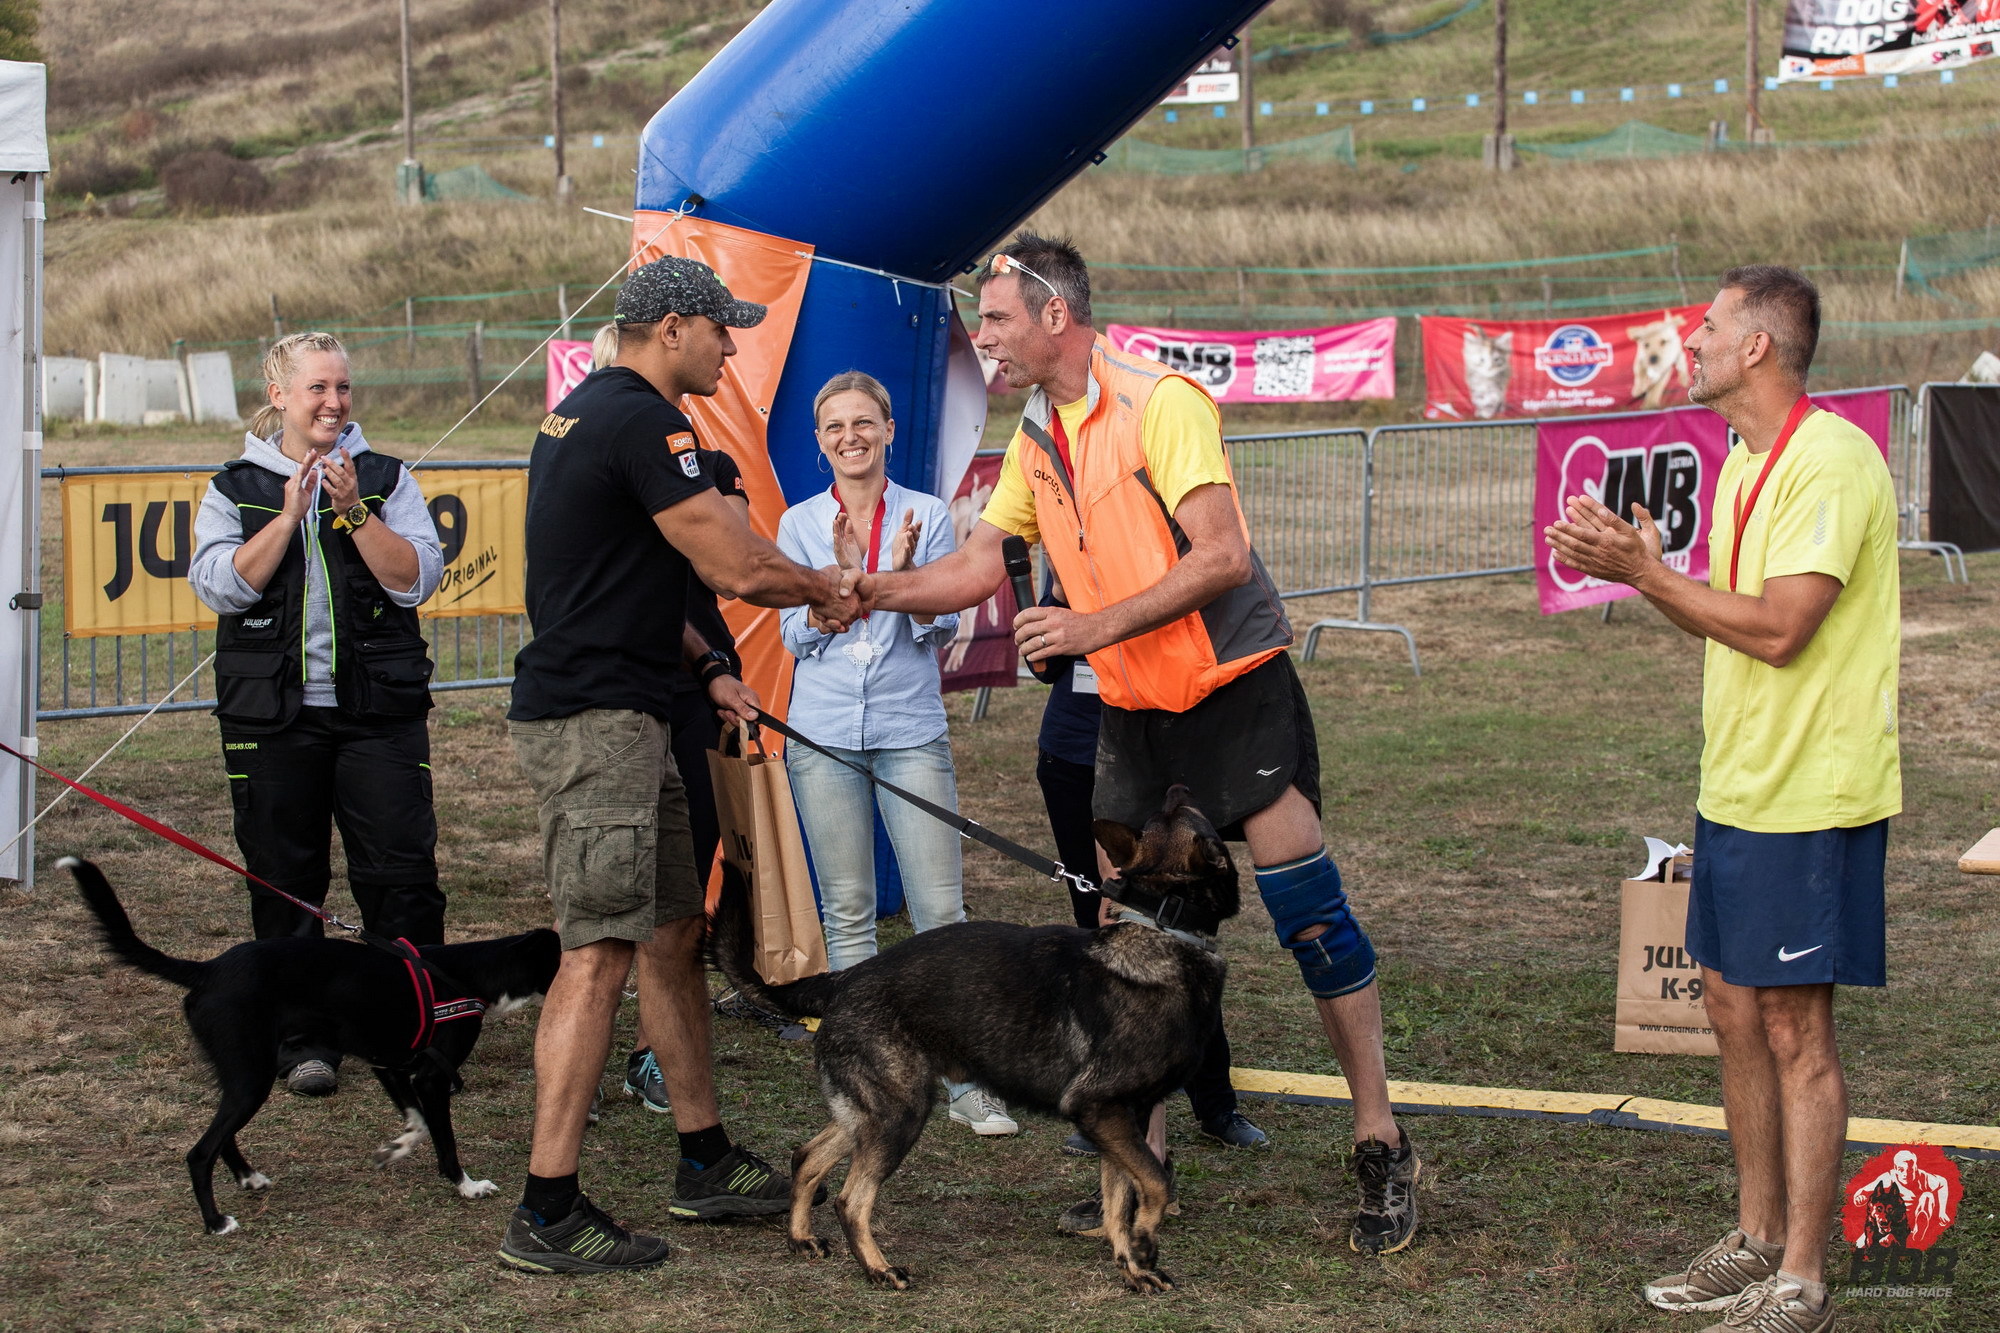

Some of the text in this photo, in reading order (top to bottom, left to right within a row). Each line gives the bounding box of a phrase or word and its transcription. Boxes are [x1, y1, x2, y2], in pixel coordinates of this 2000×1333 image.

[439, 545, 498, 593] ORIGINAL
[1661, 977, 1704, 1001] K-9
[1638, 1023, 1715, 1035] WWW.ORIGINAL-K9.
